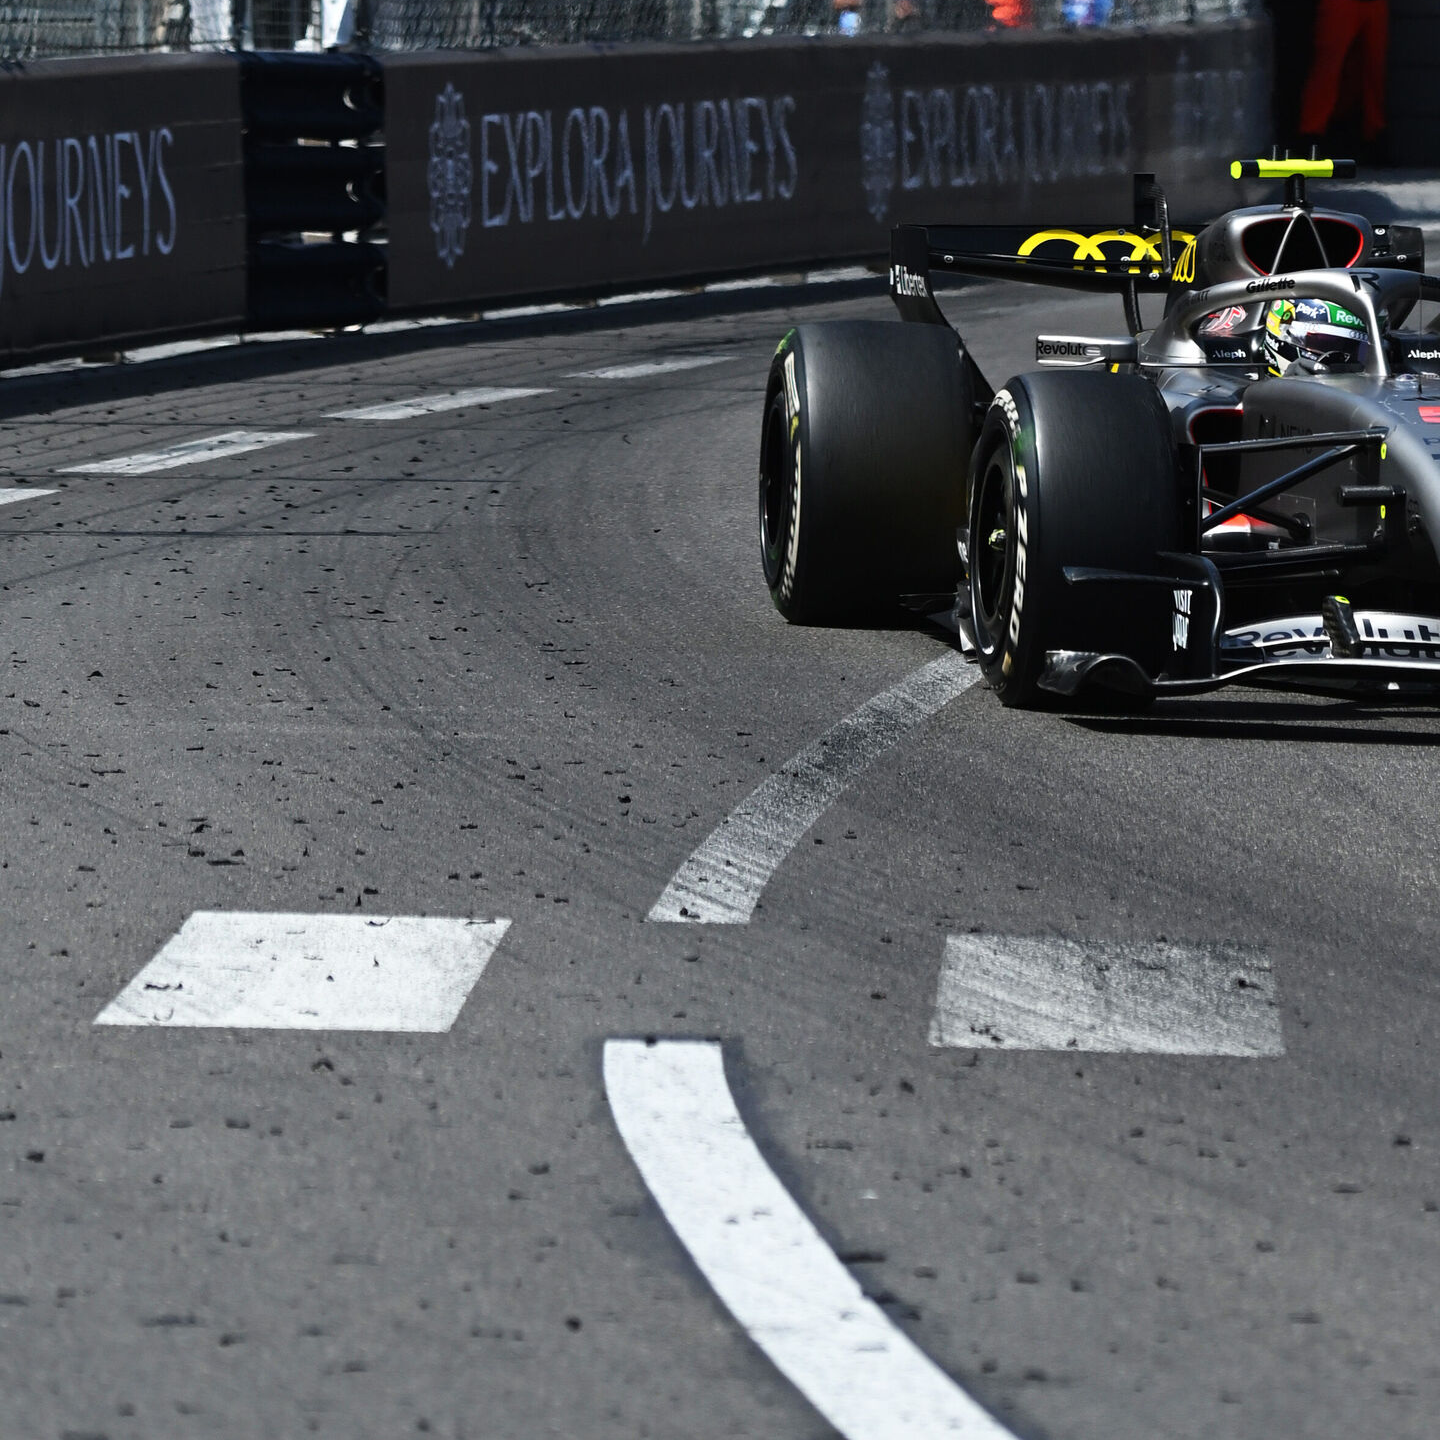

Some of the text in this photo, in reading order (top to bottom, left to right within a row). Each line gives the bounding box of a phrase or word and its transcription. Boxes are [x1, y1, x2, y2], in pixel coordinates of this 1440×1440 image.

[480, 95, 797, 244] EXPLORA JOURNEYS
[1245, 277, 1296, 294] Gillette
[1213, 349, 1247, 359] Aleph
[1009, 508, 1028, 647] ZERO
